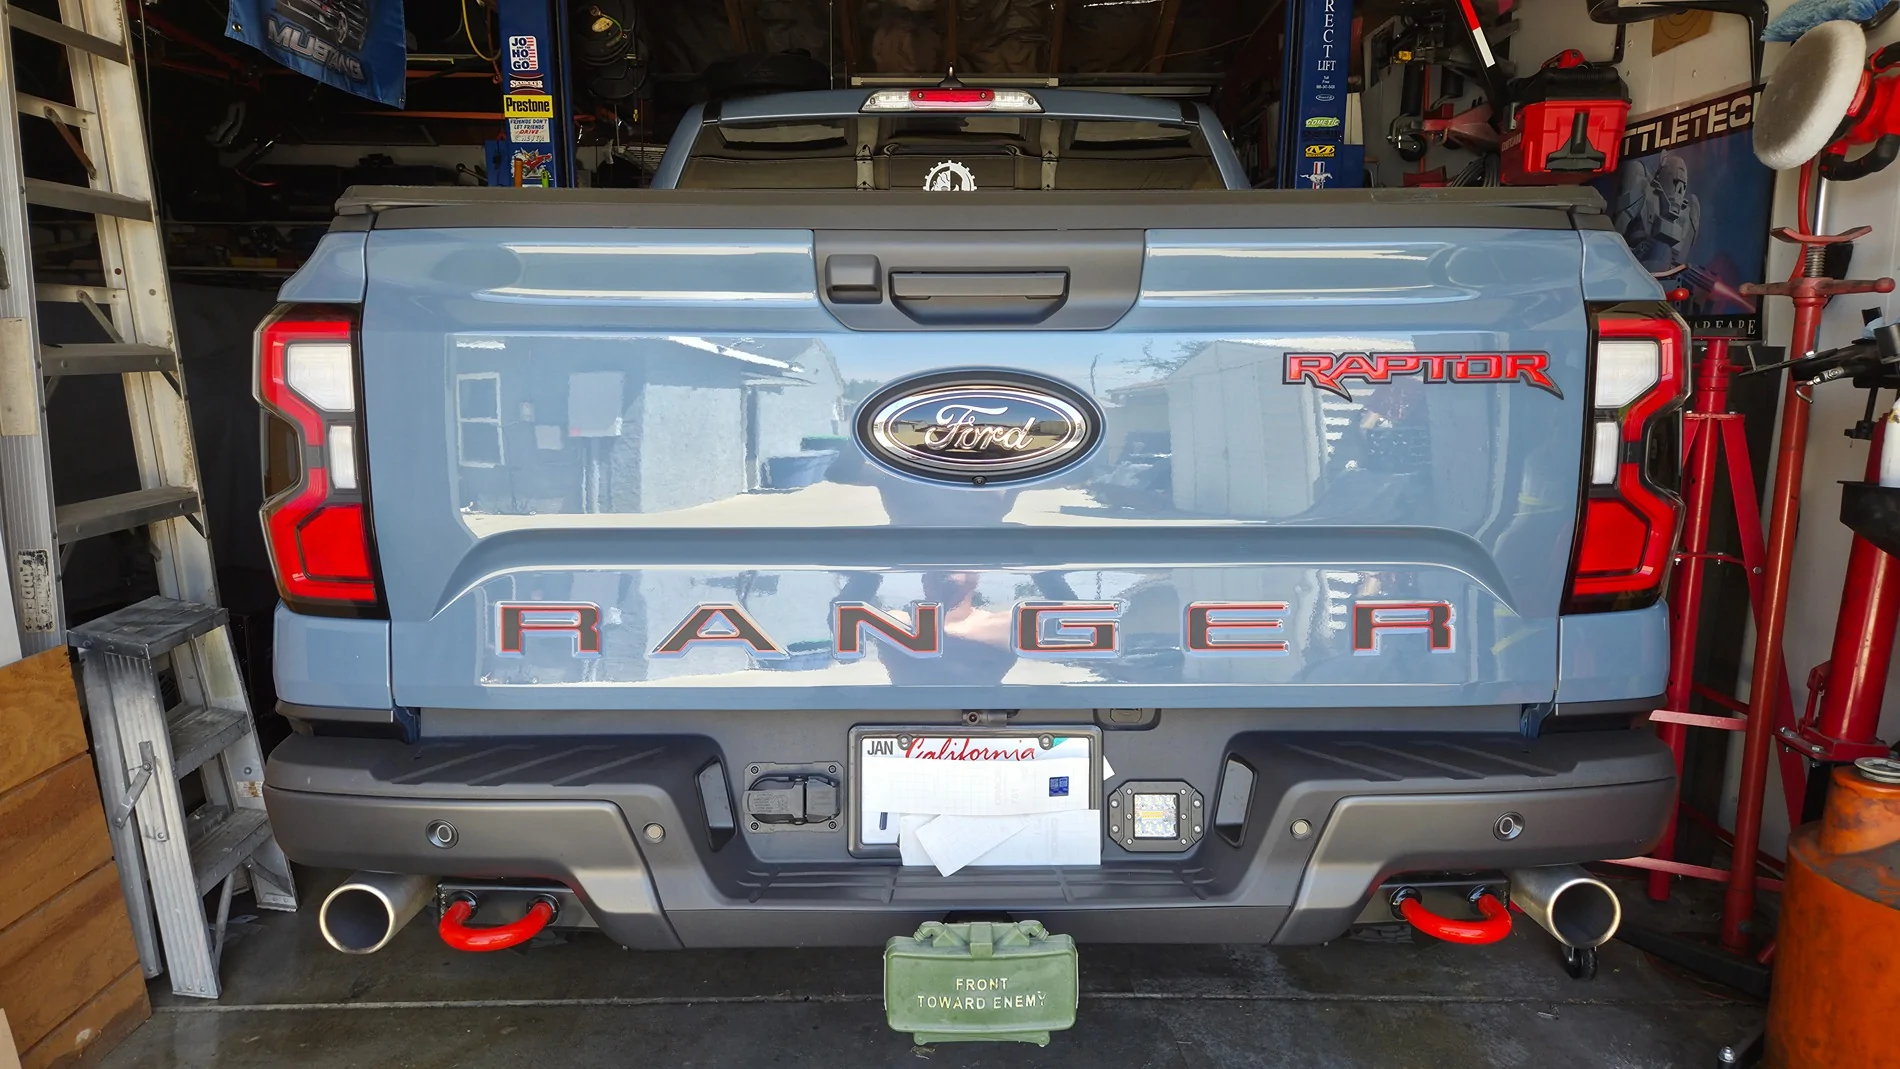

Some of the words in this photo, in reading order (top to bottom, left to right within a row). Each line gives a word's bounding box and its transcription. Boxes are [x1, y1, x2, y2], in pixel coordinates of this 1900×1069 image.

[267, 16, 365, 81] MUSTANG
[512, 38, 527, 46] JO
[512, 49, 529, 58] HO
[513, 61, 530, 69] GO
[1317, 60, 1336, 71] LIFT
[506, 97, 550, 112] Prestone
[1306, 117, 1340, 128] COMETIC
[1282, 351, 1565, 402] RAPTOR
[924, 404, 1037, 451] Ford
[494, 600, 1457, 659] RANGER
[867, 741, 894, 756] JAN
[905, 738, 1036, 762] California
[956, 978, 1008, 991] FRONT
[917, 995, 986, 1010] TOWARD
[993, 991, 1047, 1010] ENEMY
